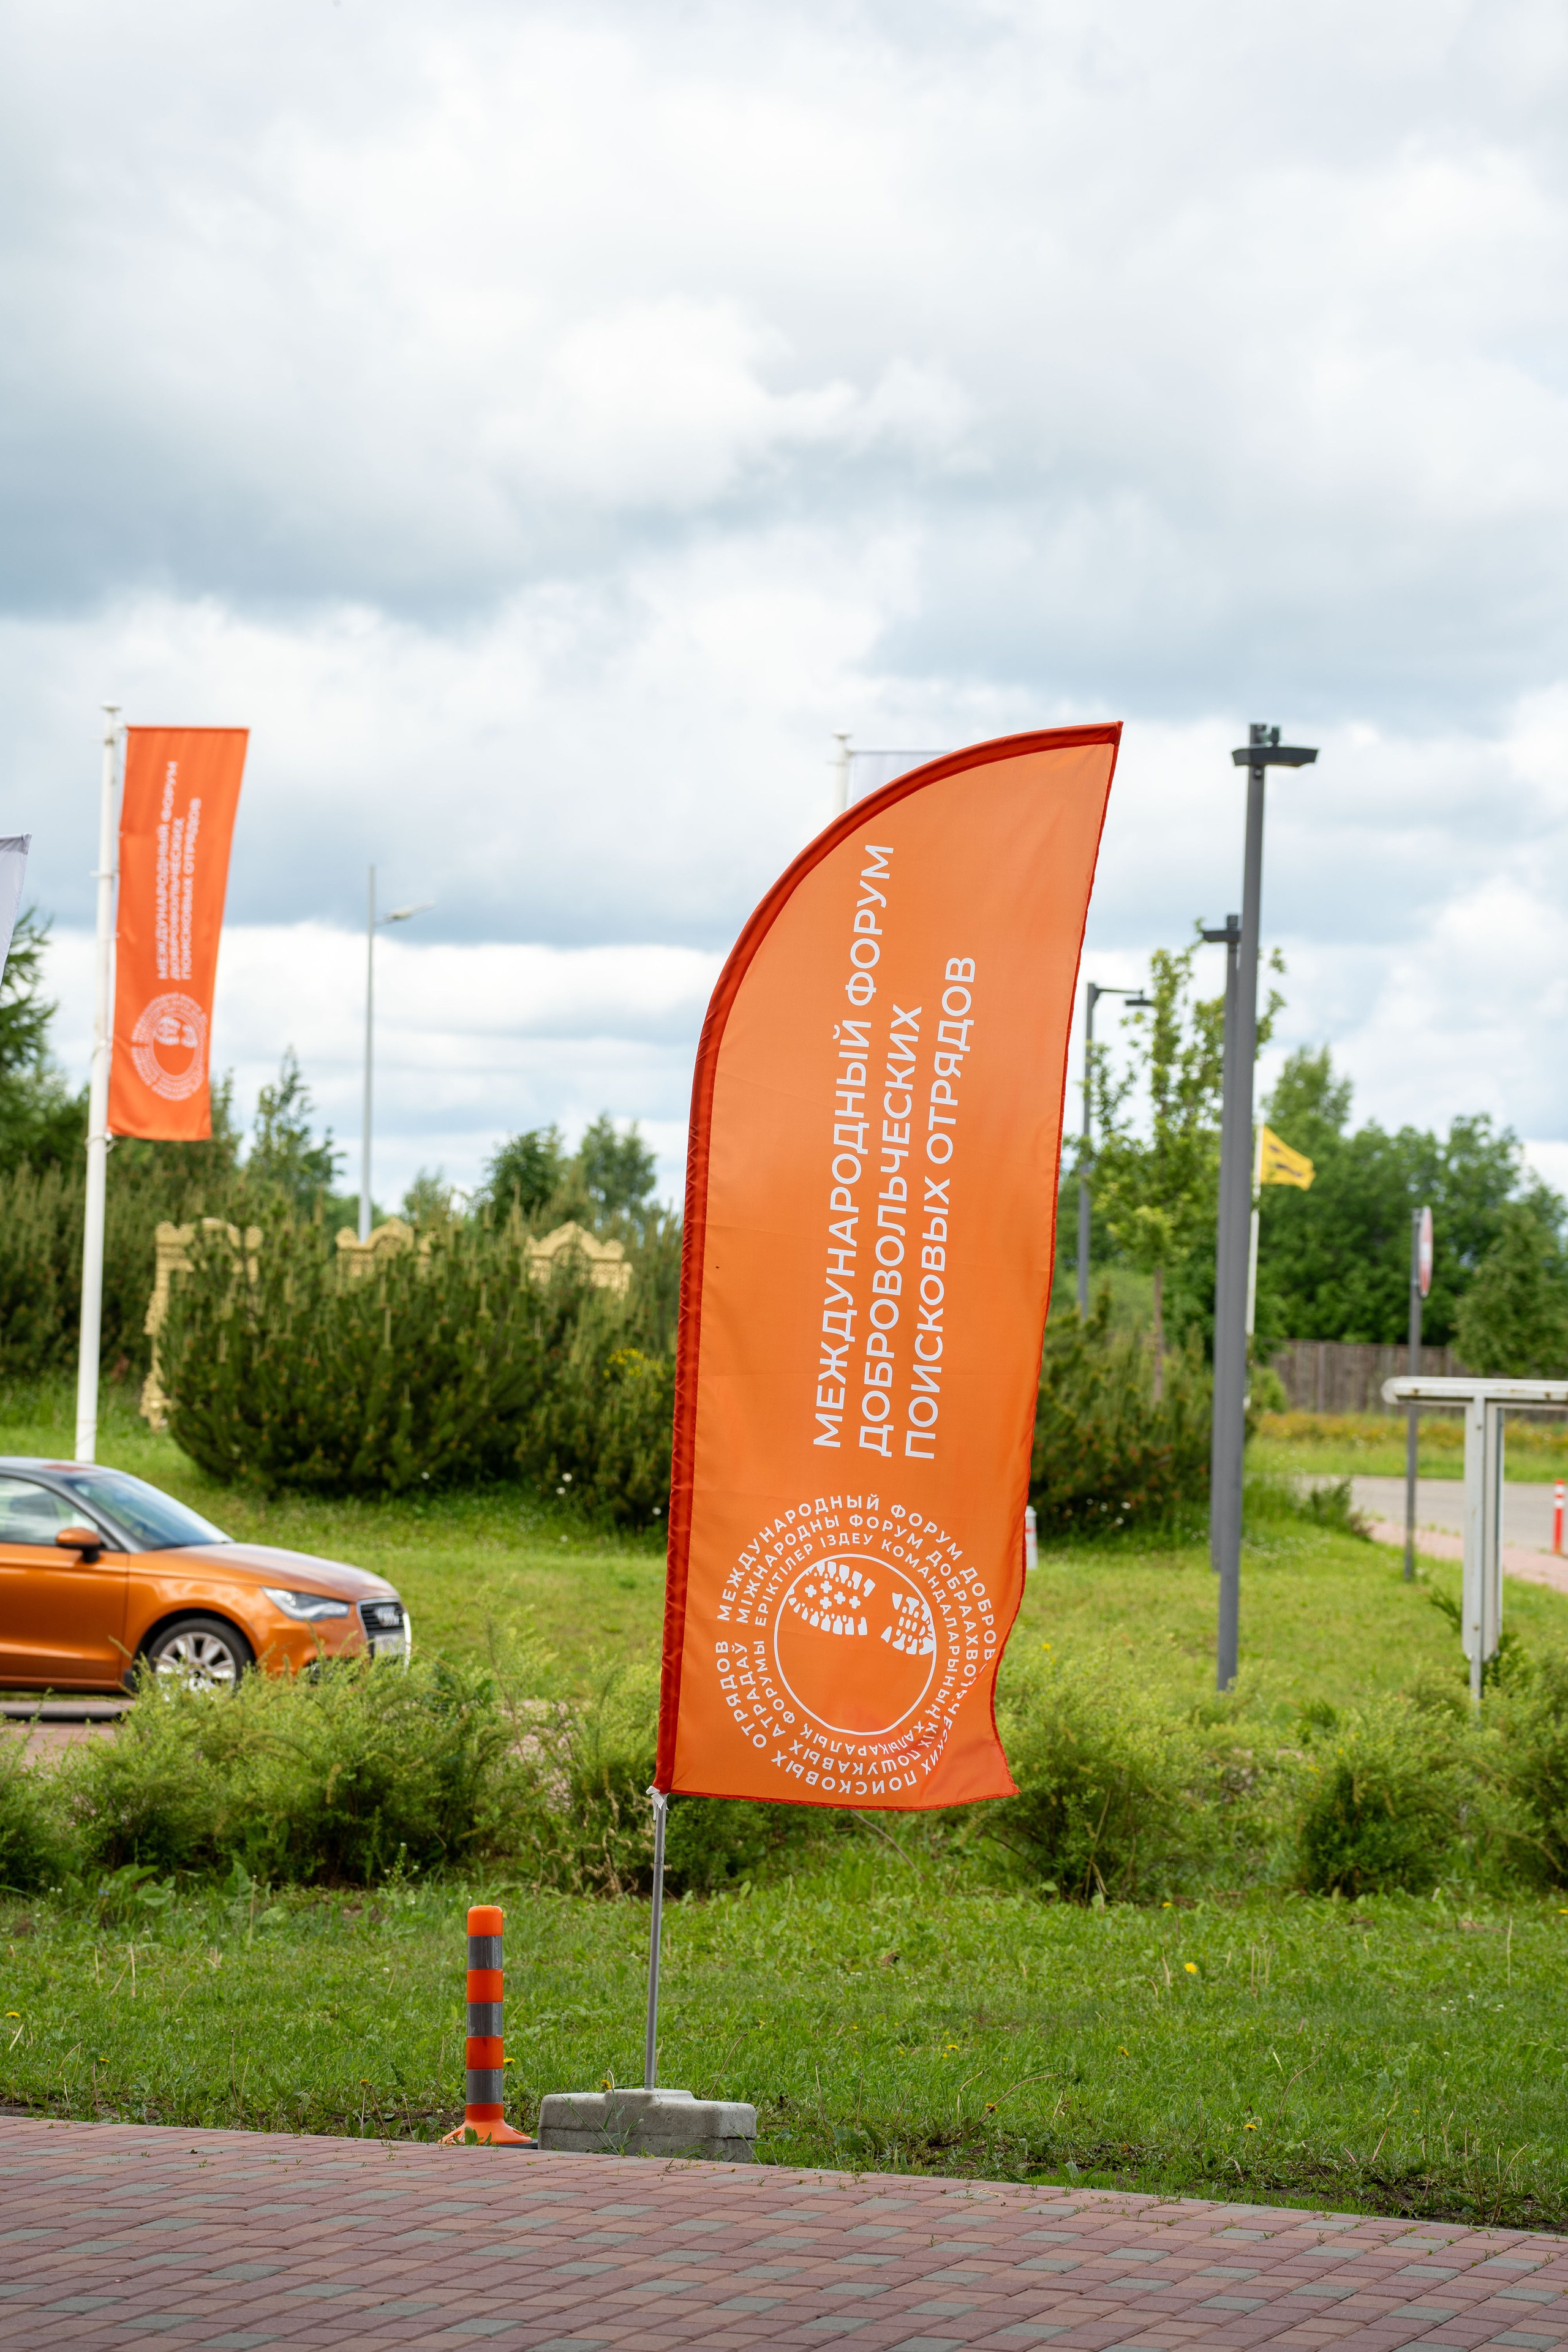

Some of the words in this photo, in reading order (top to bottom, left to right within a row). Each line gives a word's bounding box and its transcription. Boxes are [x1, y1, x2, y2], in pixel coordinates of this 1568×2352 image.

[925, 957, 976, 1164] ОТРЯДОВ
[813, 1019, 872, 1447] МЕЖДУНАРОДНЫЙ
[845, 844, 894, 1006] ФОРУМ
[859, 1005, 922, 1457] ДОБРОВОЛЬЧЕСКИХ
[905, 1176, 951, 1459] ПОИСКОВЫХ
[717, 1493, 879, 1621] МЕЖДУНАРОДНЫЙ
[736, 1515, 840, 1624] МІЖНАРОДНЫ
[820, 1532, 873, 1548] ІЗДЕУ
[849, 1514, 923, 1550] ФОРУМ
[891, 1504, 963, 1561] ФОРУМ
[755, 1543, 813, 1627] ЕРІКТІЛЕР
[881, 1539, 960, 1719] КОМАНДАЛАРЫНЫҢ
[715, 1641, 767, 1748] ОТРЯДОВ
[731, 1642, 786, 1738] АТРАДАЎ
[753, 1640, 796, 1724] ФОРУМЫ
[771, 1749, 917, 1795] ПОИСКОВЫХ
[788, 1739, 921, 1775] ПОШУКАВЫХ
